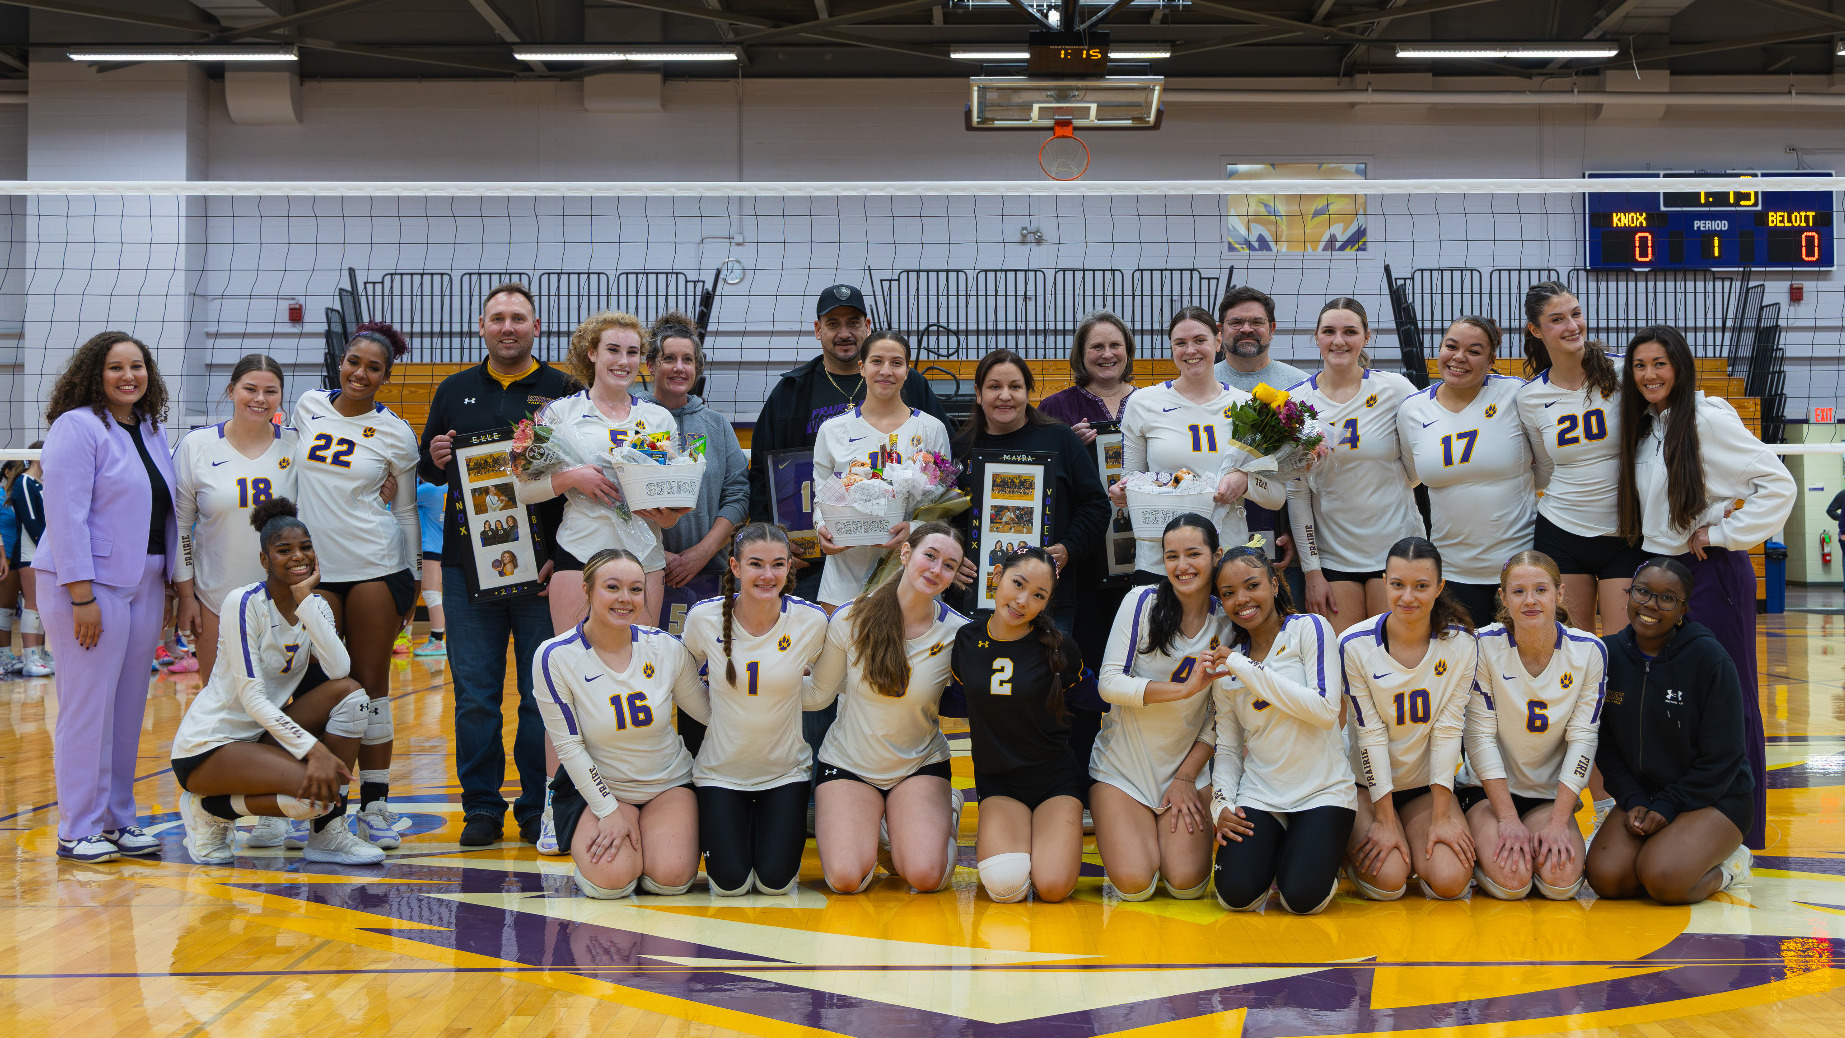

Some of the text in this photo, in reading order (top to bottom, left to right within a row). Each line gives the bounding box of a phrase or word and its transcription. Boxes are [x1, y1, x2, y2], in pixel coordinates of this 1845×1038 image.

[1060, 49, 1102, 59] 1:15
[1612, 212, 1647, 228] KNOX
[1693, 220, 1729, 231] PERIOD
[1768, 211, 1816, 227] BELOIT
[1634, 232, 1653, 262] 0
[1713, 237, 1719, 257] 1
[1801, 231, 1819, 262] 0
[1556, 407, 1609, 449] 20
[1814, 407, 1834, 423] EXIT
[307, 432, 357, 470] 22
[1188, 423, 1219, 454] 11
[1439, 428, 1480, 469] 17
[868, 450, 903, 470] 1
[1003, 453, 1033, 463] MAYRA
[235, 476, 274, 509] 18
[453, 489, 468, 536] KNOX
[834, 519, 890, 535] SENIOR
[971, 507, 980, 549] KNOX
[181, 534, 194, 567] PRAIRIE
[1304, 524, 1320, 557] PRAIRIE
[668, 603, 688, 637] 5
[279, 643, 300, 675] 7
[745, 660, 761, 697] 1
[989, 657, 1015, 696] 2
[608, 690, 655, 732] 16
[1393, 687, 1432, 727] 10
[1526, 698, 1550, 734] 6
[588, 764, 611, 799] PRAIRIE
[1360, 747, 1377, 788] PRAIRIE
[1573, 754, 1591, 779] FIRE
